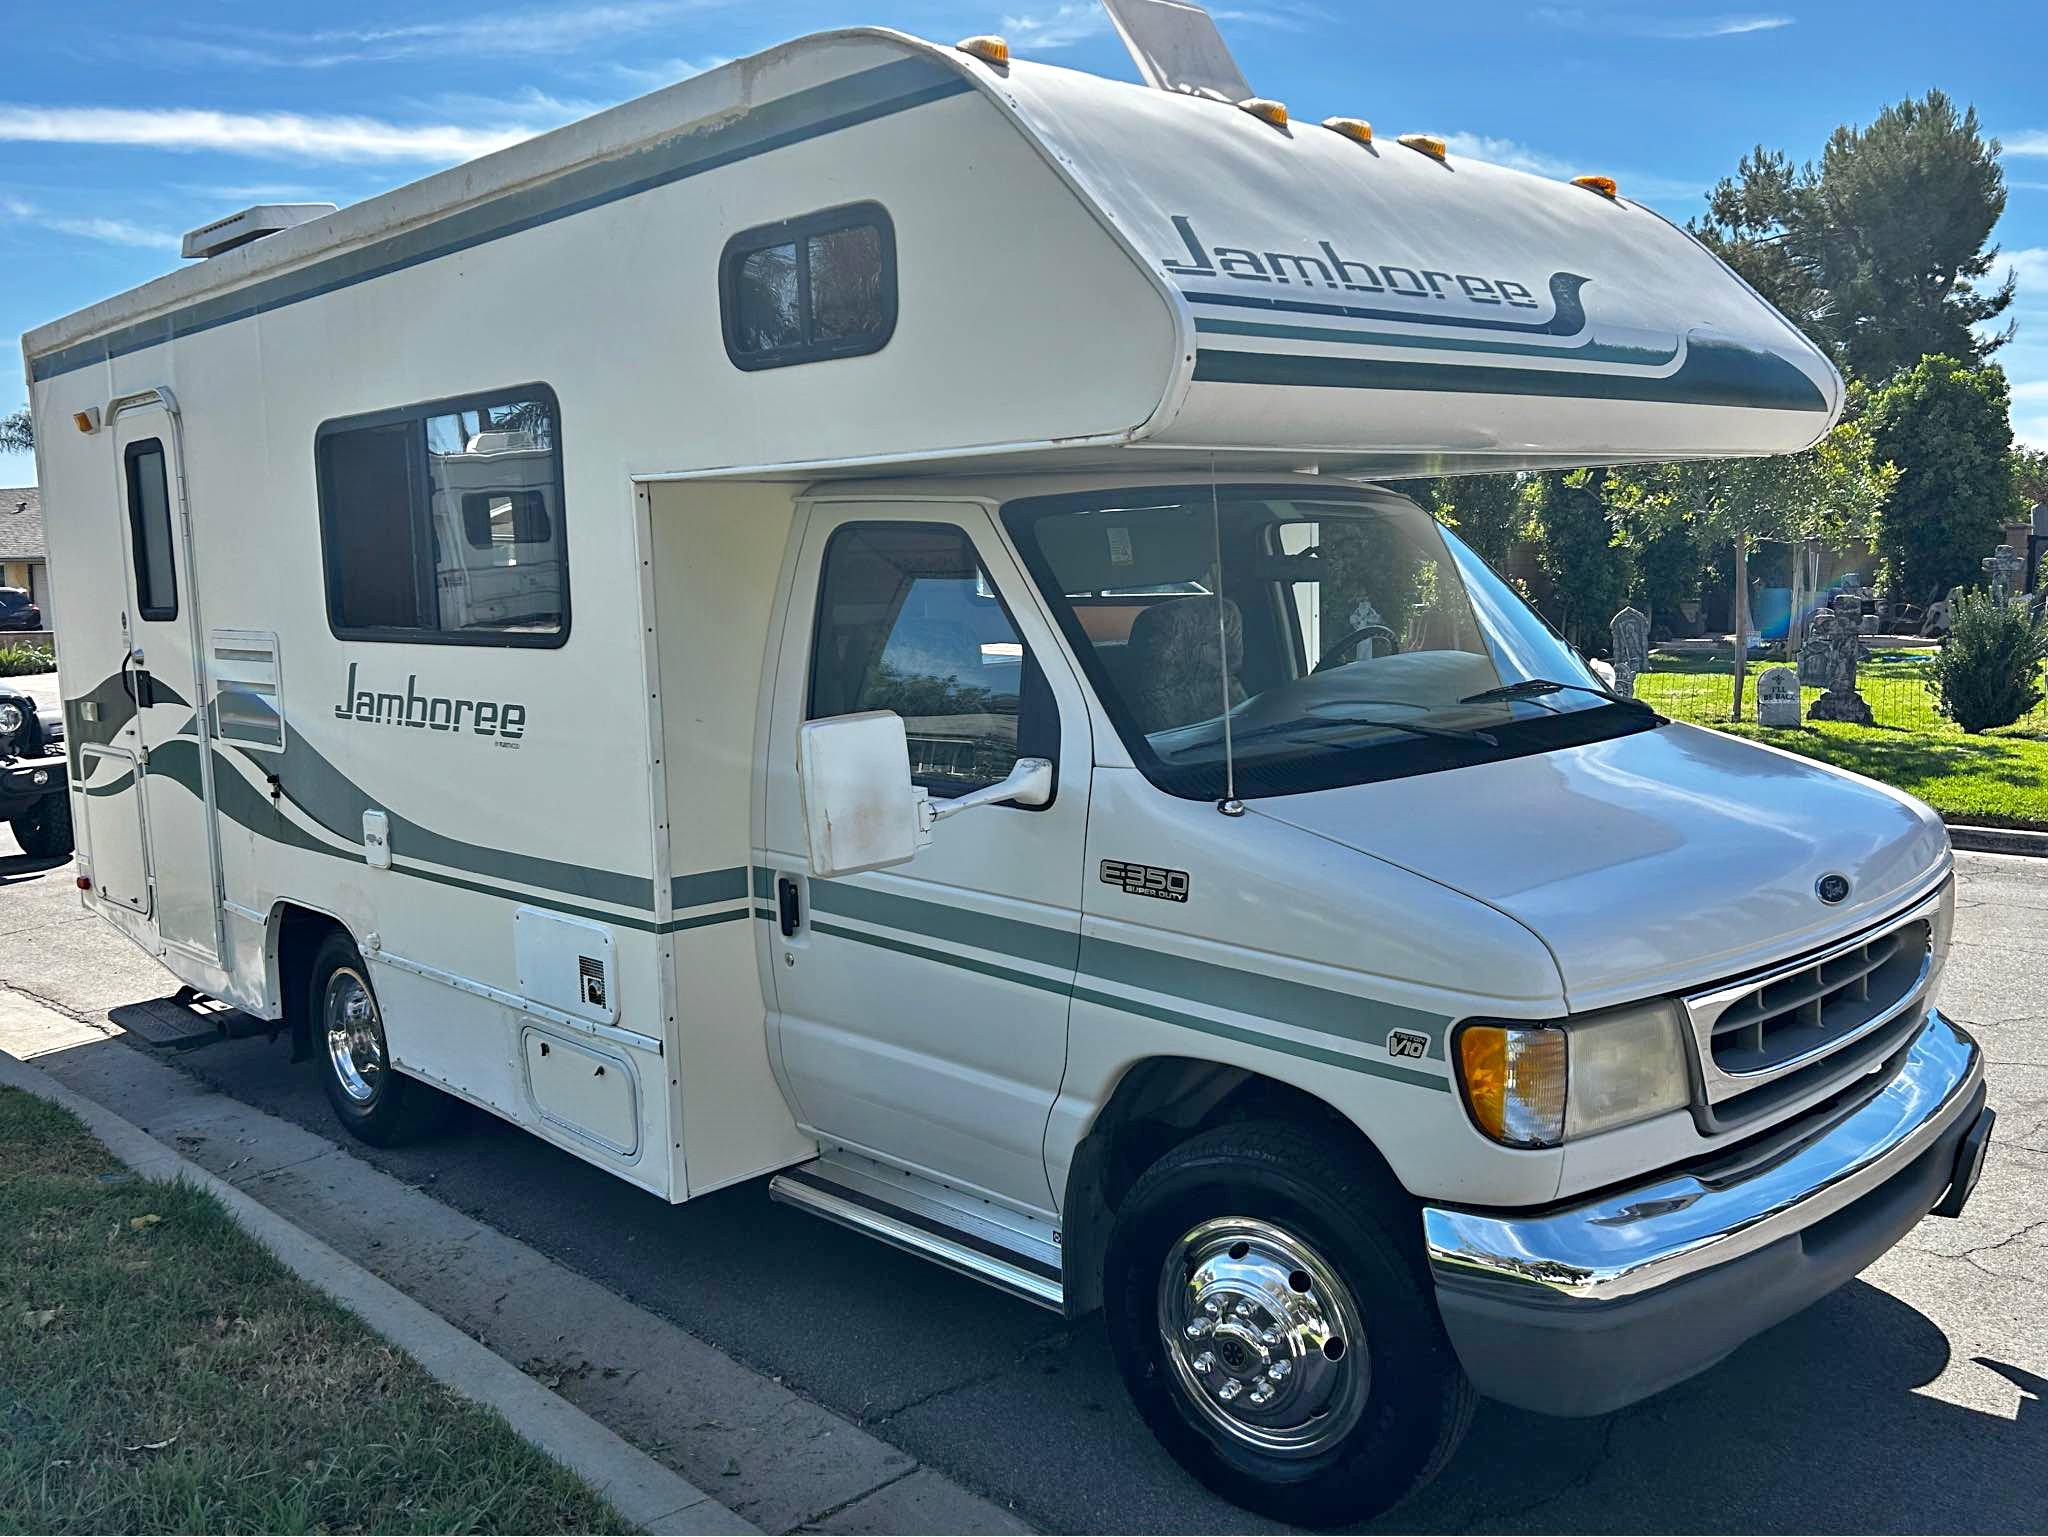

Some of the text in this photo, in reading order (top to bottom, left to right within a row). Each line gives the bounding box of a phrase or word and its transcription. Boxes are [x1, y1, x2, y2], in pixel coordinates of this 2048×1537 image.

[1162, 215, 1538, 309] Jamboree
[335, 662, 526, 739] Jamboree
[1126, 885, 1184, 901] SUPER DUTY
[1390, 1037, 1423, 1057] V10
